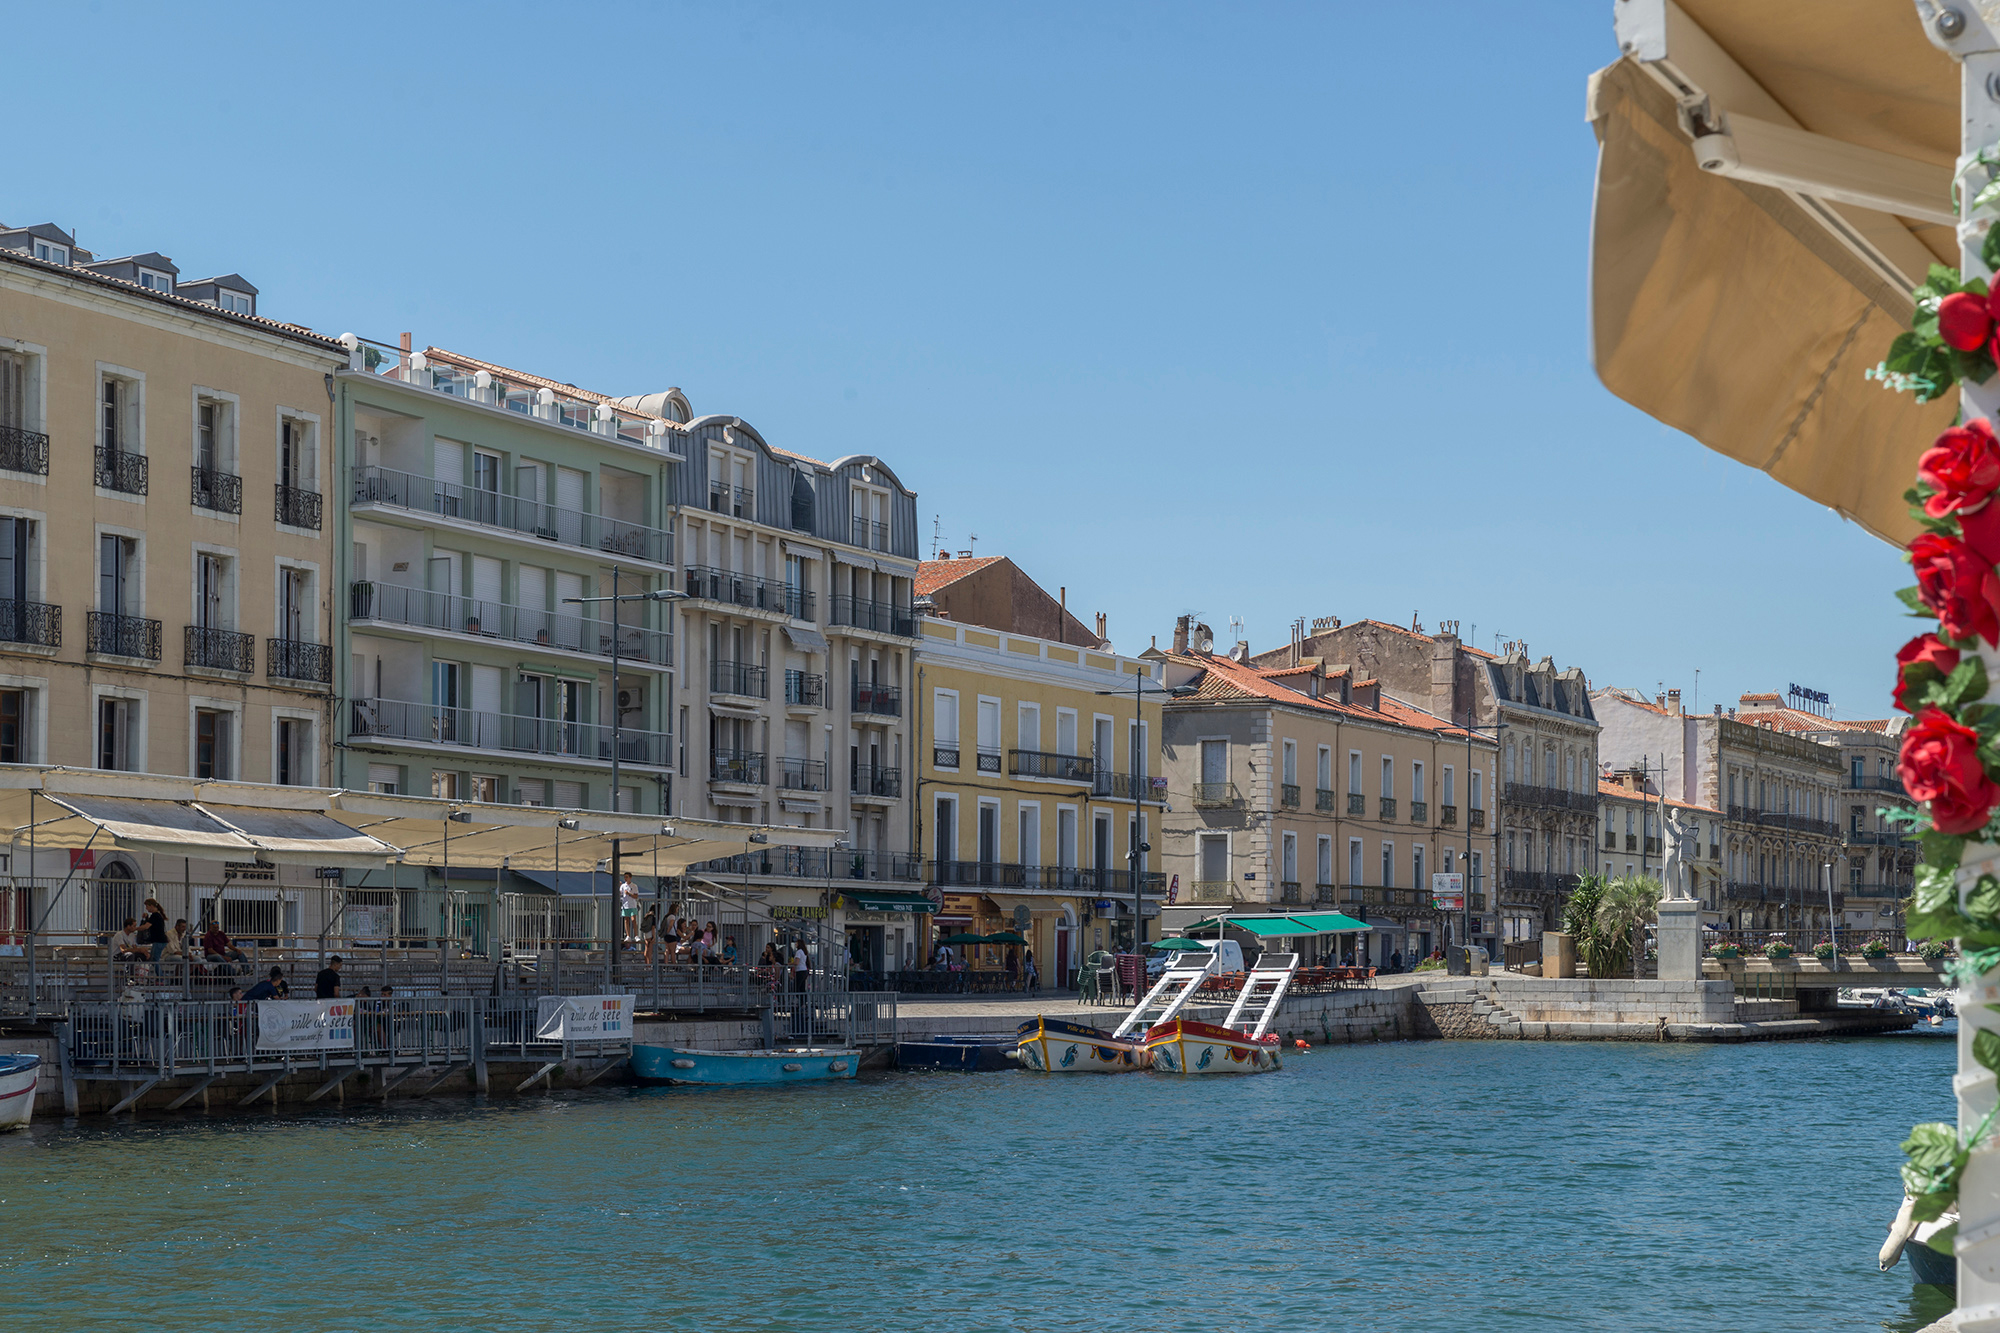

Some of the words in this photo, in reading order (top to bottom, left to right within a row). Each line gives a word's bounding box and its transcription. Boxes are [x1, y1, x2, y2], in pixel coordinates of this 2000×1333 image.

[1170, 875, 1178, 905] TABAC
[773, 906, 798, 918] AGENCE
[291, 1013, 312, 1029] ville
[589, 1006, 600, 1021] de
